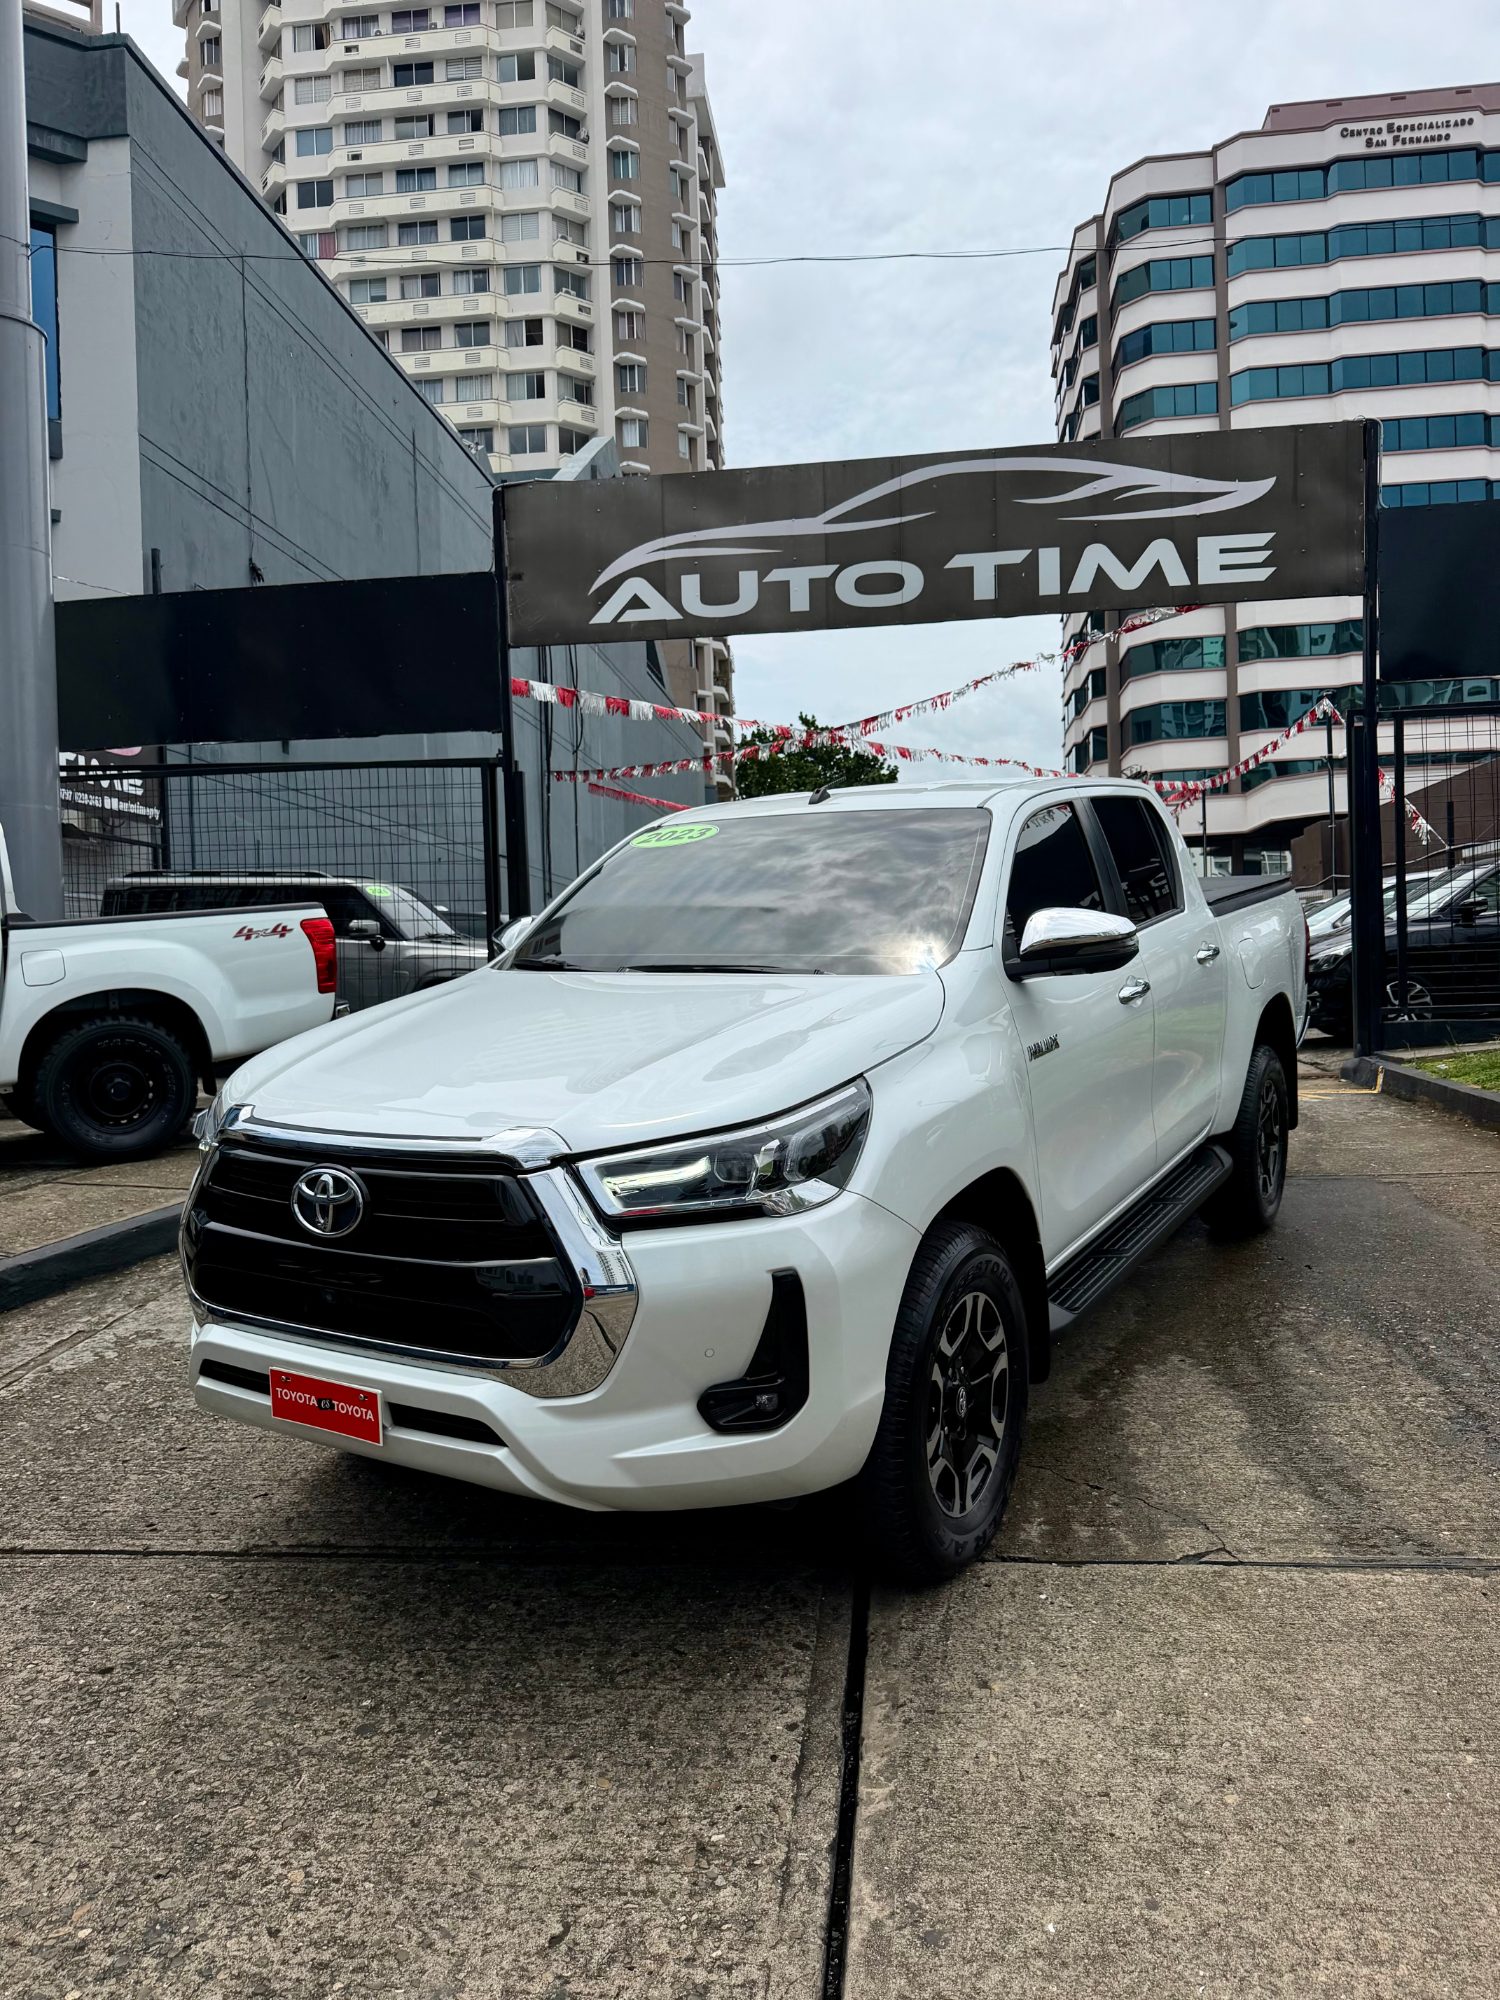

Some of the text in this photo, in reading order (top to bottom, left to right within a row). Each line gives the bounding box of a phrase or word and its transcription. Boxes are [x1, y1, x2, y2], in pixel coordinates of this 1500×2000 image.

[1341, 117, 1475, 138] CENTRO ESPECIALIZADO
[1366, 132, 1451, 148] SAN FERNANDO
[589, 531, 1278, 626] AUTO TIME
[636, 827, 713, 845] 2023
[276, 1387, 375, 1422] TOYOTA es TOYOTA
